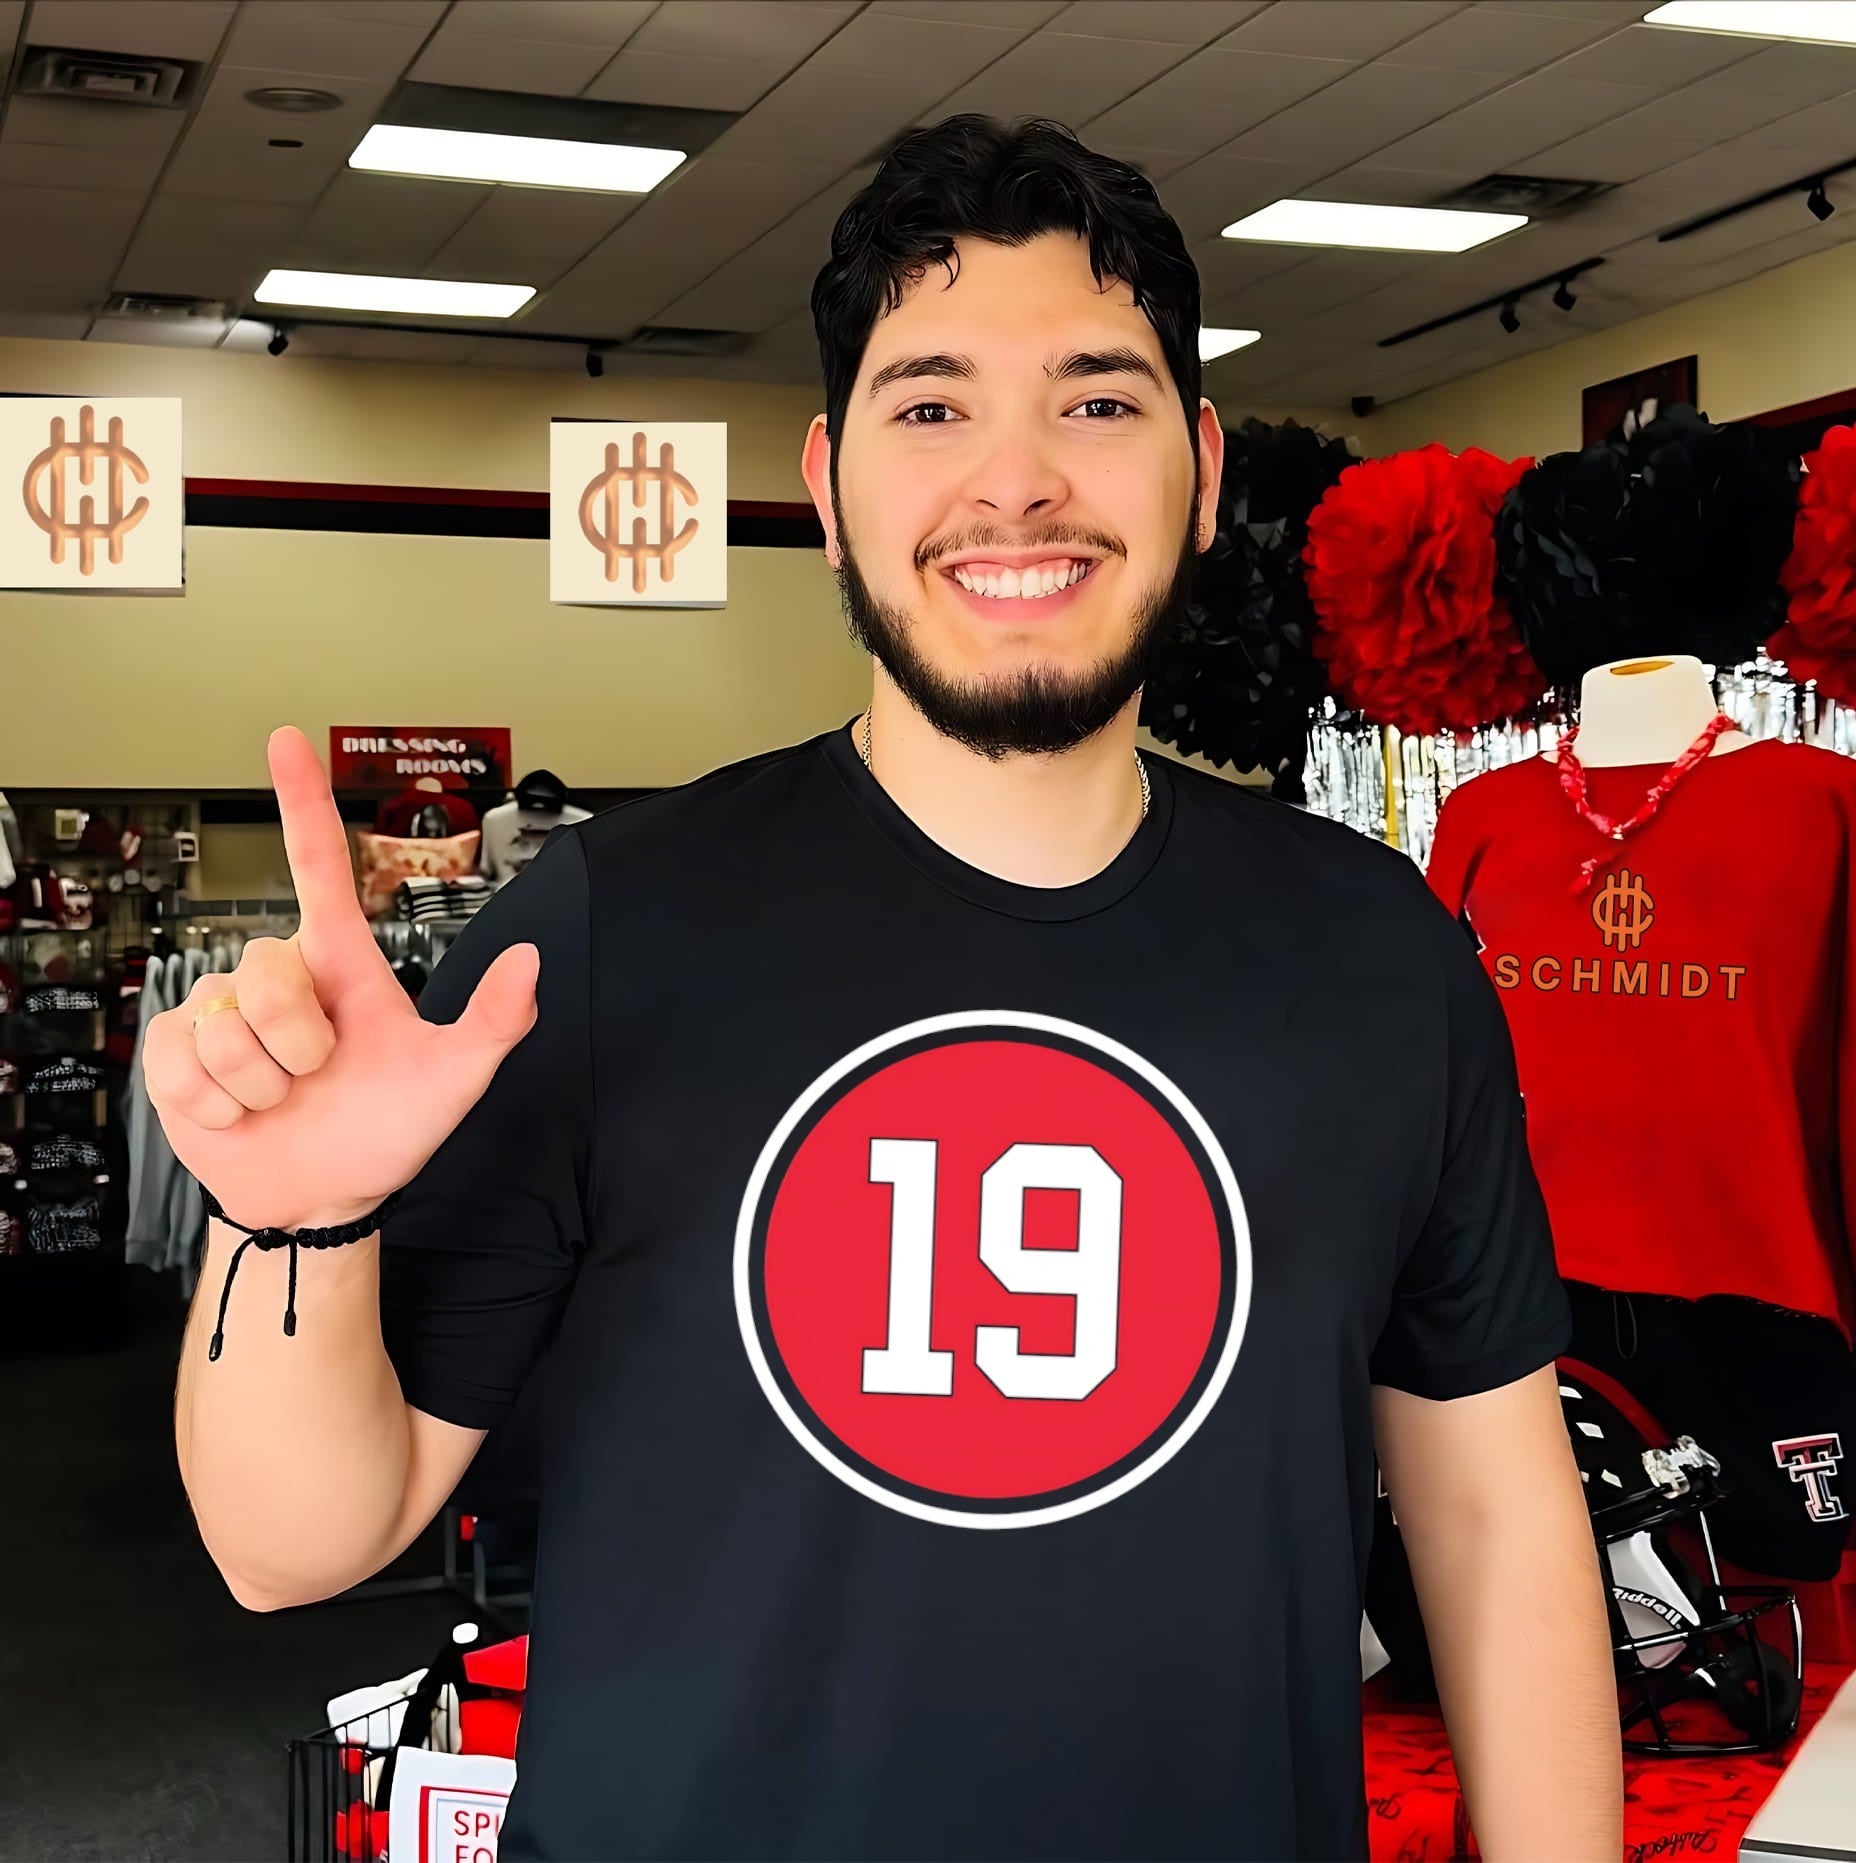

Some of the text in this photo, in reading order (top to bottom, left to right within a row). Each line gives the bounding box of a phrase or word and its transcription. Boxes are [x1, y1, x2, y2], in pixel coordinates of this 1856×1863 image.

[342, 737, 467, 753] DRESSING
[396, 758, 487, 775] ROOMS
[1494, 953, 1747, 1000] SCHMIDT
[861, 1137, 1123, 1401] 19
